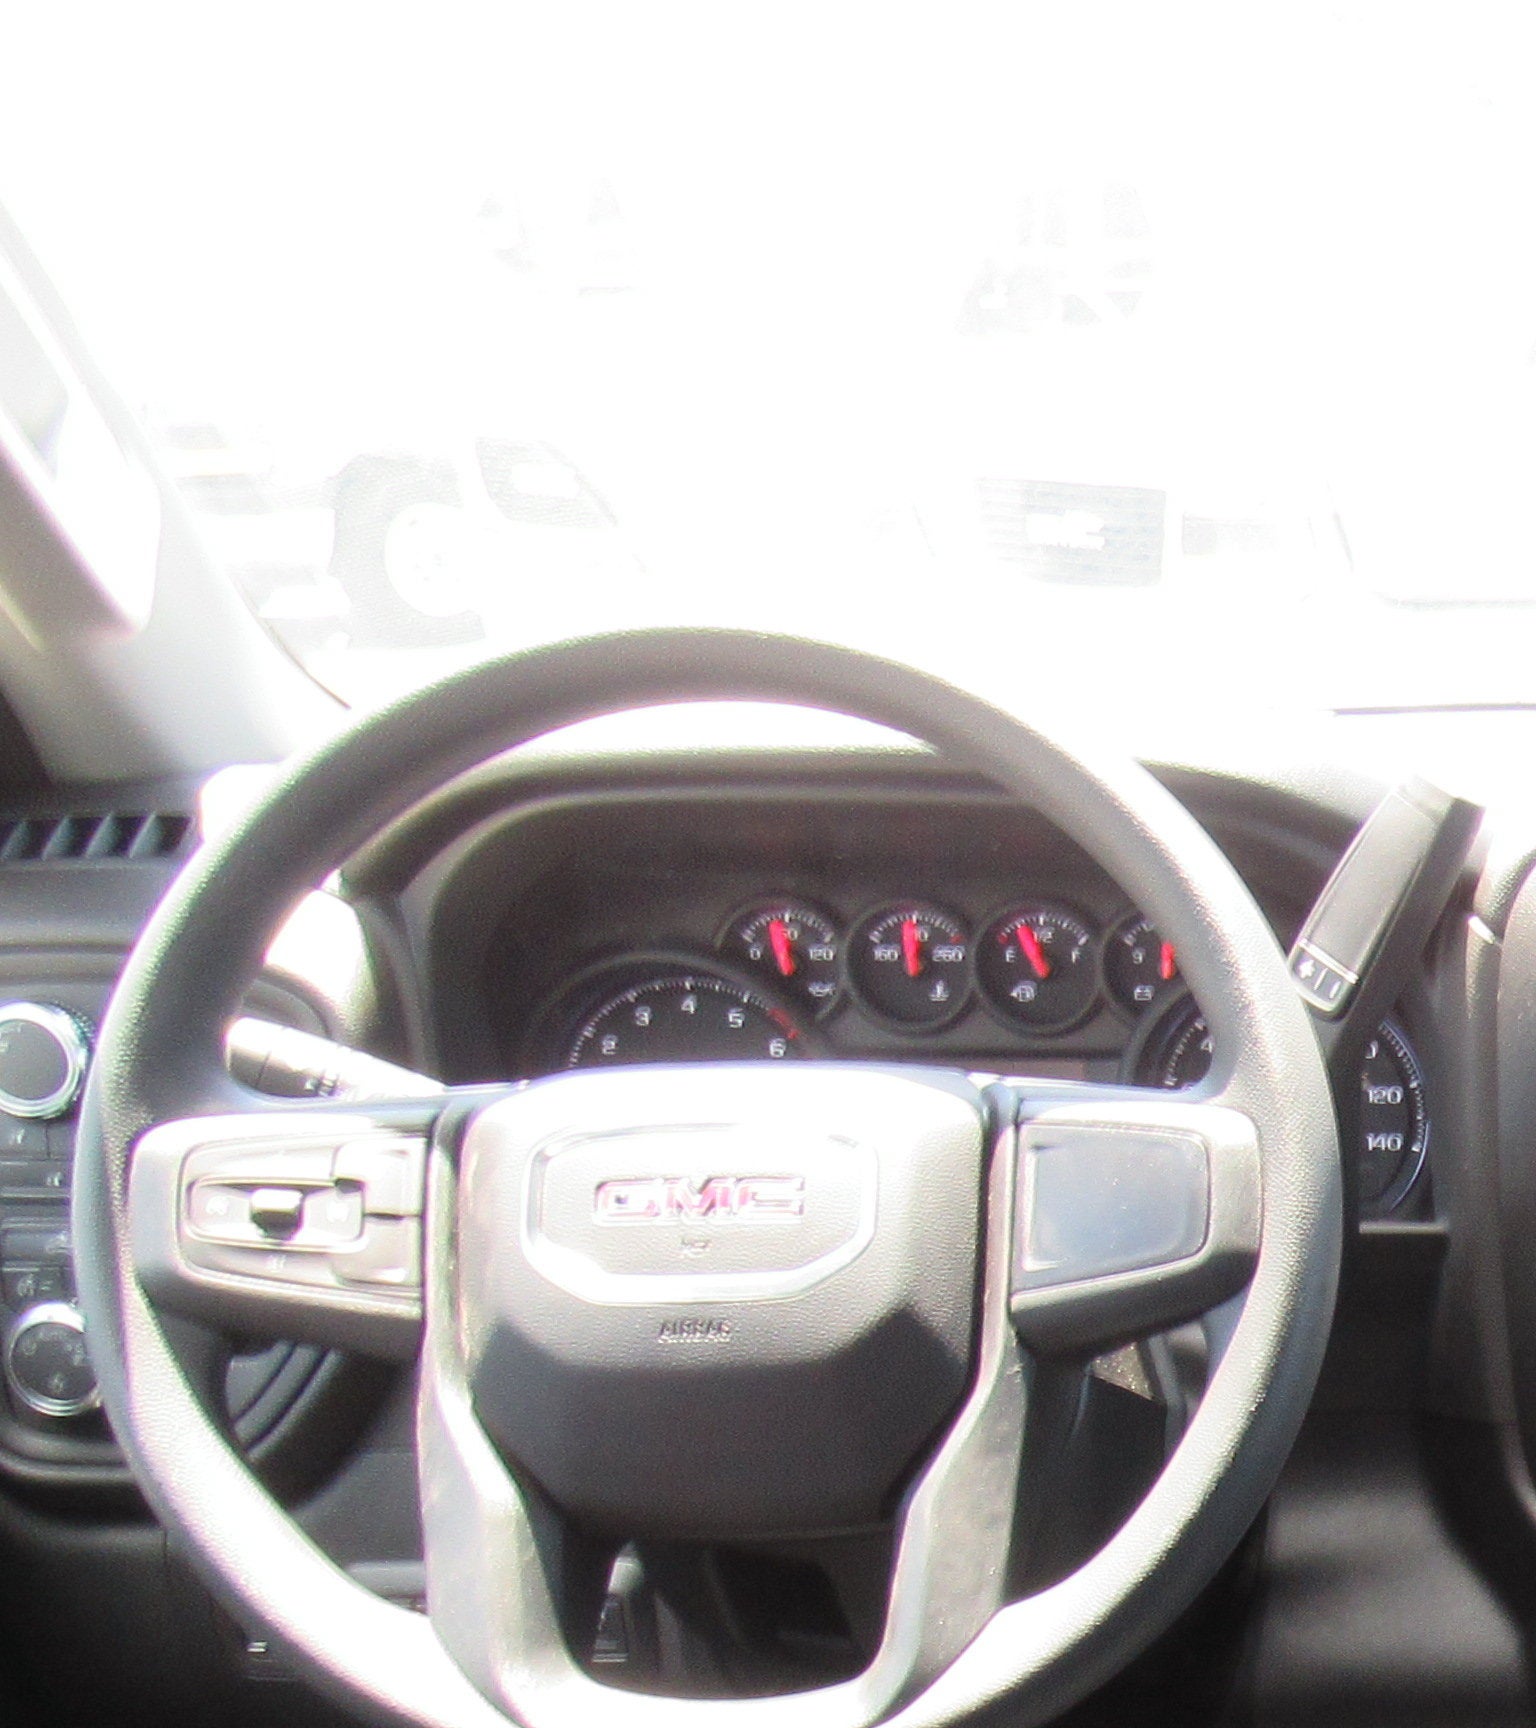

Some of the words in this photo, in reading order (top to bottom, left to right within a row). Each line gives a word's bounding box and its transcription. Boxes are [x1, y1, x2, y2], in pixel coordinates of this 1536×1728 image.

[1005, 948, 1016, 963] E
[1131, 947, 1145, 964] 9
[681, 996, 696, 1014] 4
[634, 1006, 650, 1026] 3
[728, 1009, 744, 1028] 5
[601, 1035, 618, 1056] 2
[768, 1038, 786, 1058] 6
[1366, 1085, 1403, 1105] 120
[1366, 1132, 1404, 1152] 140
[594, 1175, 805, 1224] GMC
